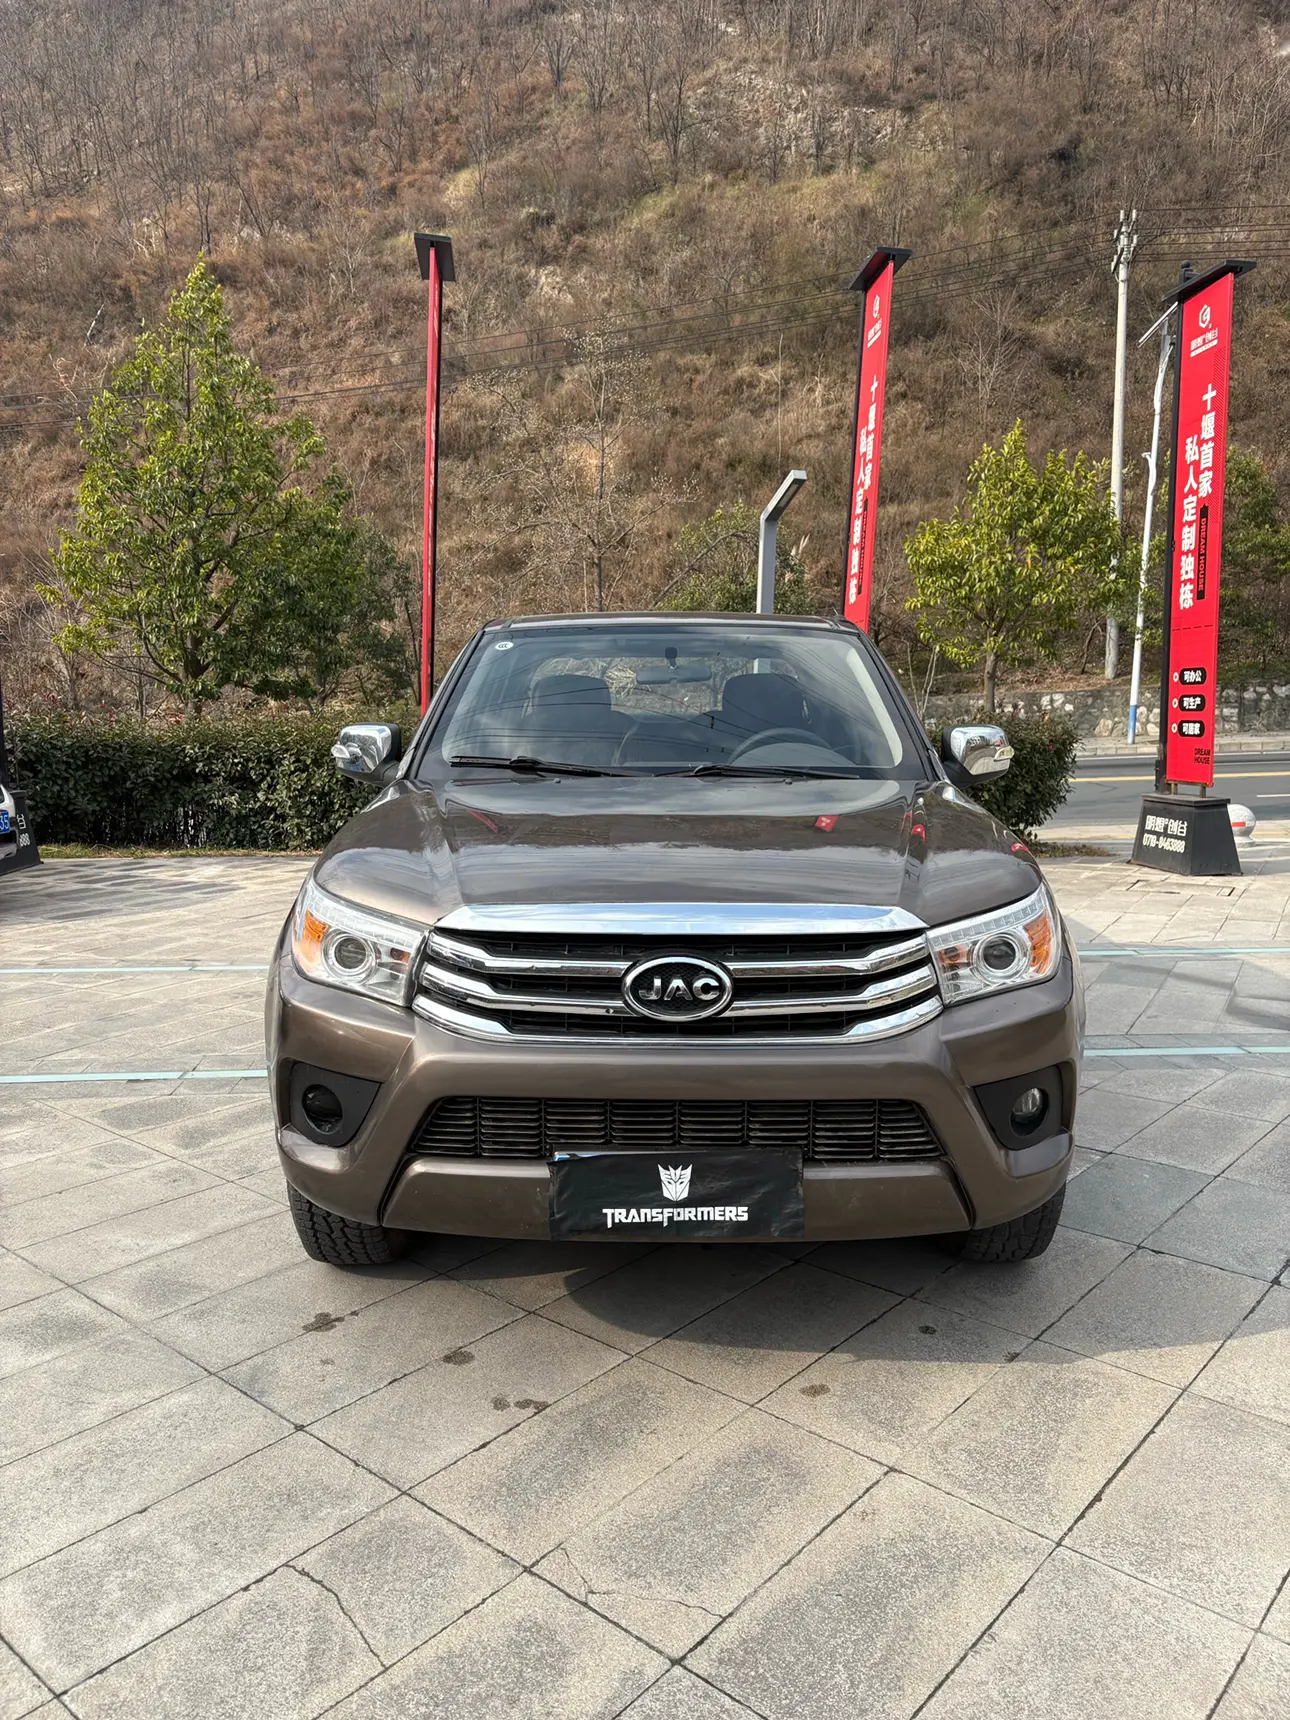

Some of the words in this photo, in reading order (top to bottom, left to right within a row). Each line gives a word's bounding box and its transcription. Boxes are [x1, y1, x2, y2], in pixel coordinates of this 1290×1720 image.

[1198, 384, 1217, 498] 十堰首家
[1179, 434, 1200, 610] 私人定制独栋
[1199, 518, 1207, 553] DREAM
[1183, 670, 1202, 683] 可办公
[1183, 697, 1201, 709] 可生产
[1194, 748, 1211, 756] DREAM
[639, 976, 720, 1000] JAC
[602, 1206, 749, 1229] TRANSFORMERS
